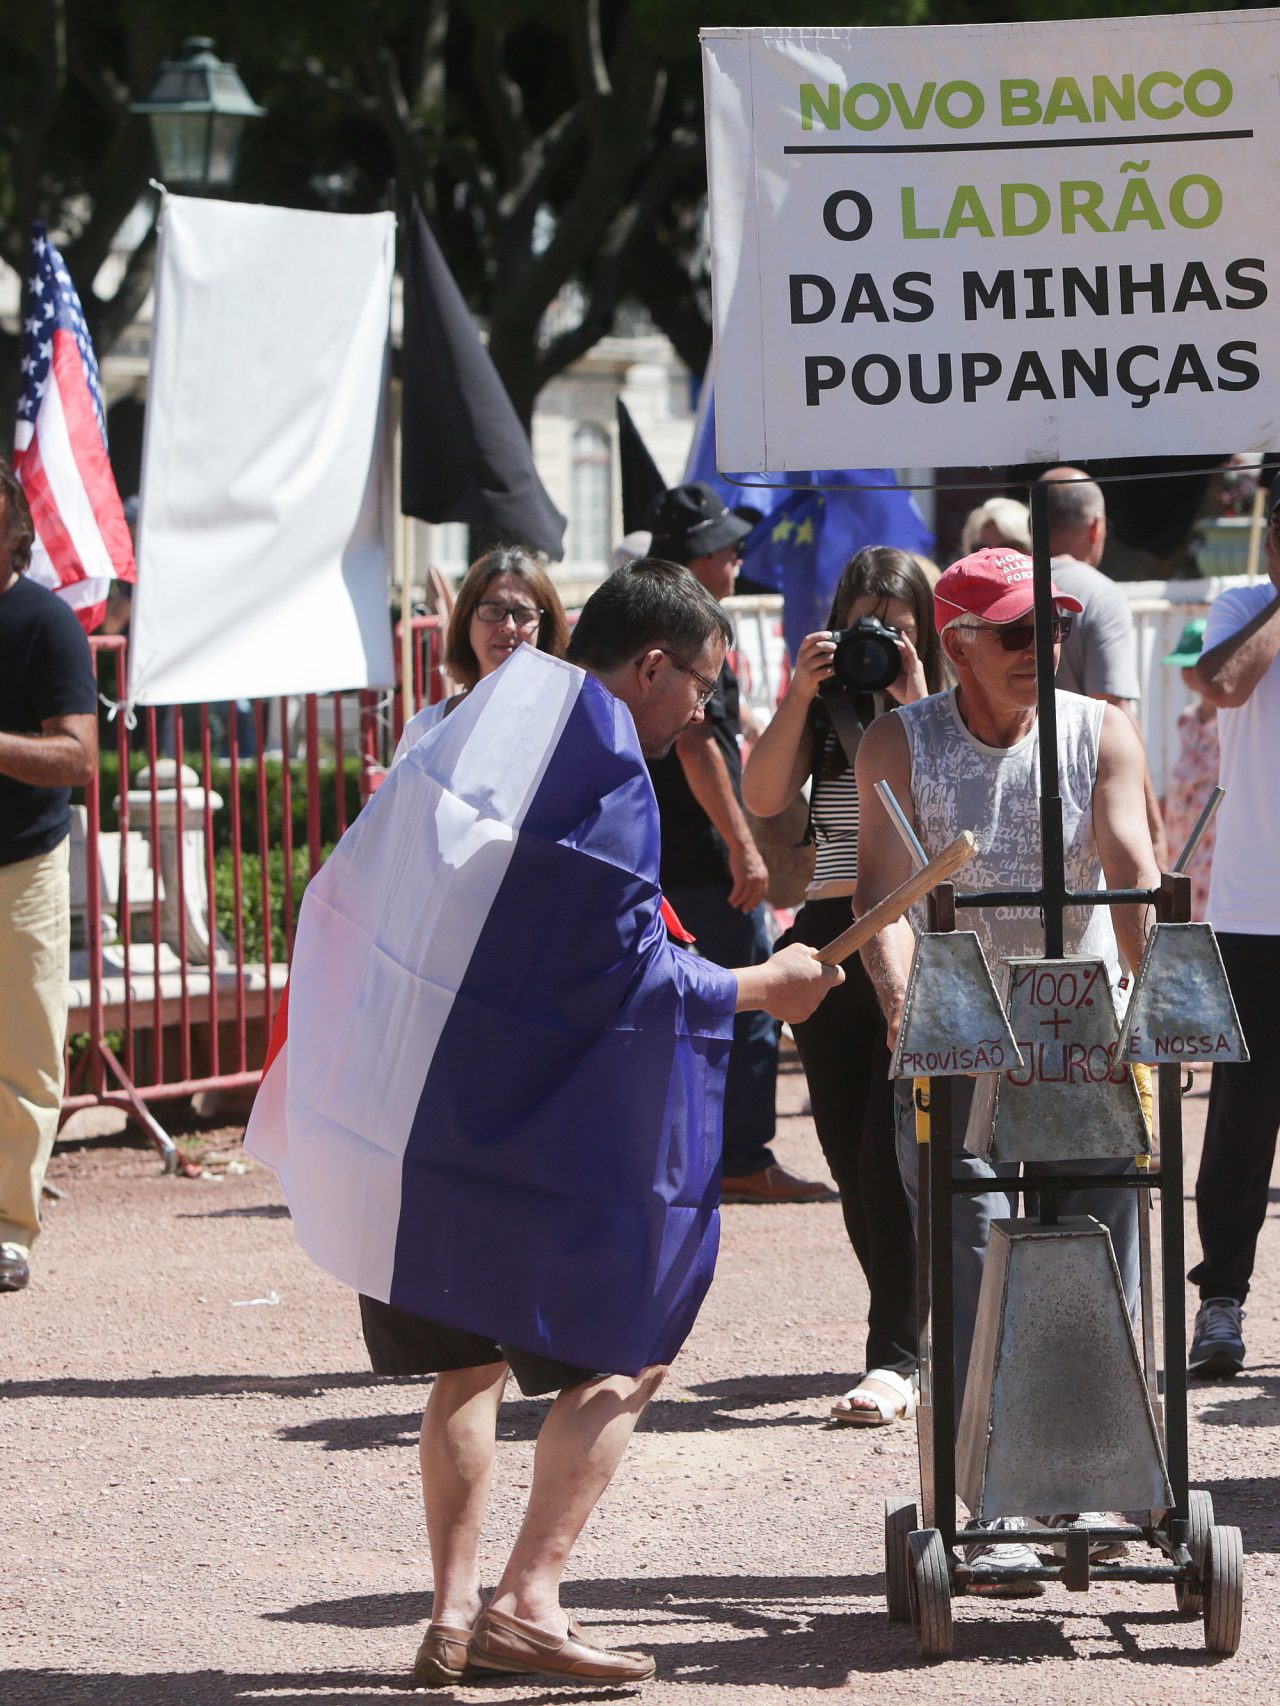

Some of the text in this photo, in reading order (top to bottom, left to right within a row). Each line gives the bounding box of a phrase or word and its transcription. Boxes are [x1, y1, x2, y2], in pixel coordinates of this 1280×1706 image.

[800, 68, 1233, 132] NOVO BANCO
[822, 159, 1223, 242] O LADRÃO
[788, 258, 1268, 325] DAS MINHAS
[804, 341, 1260, 410] POUPANÇAS
[1017, 965, 1103, 1009] 100%
[1154, 1032, 1231, 1056] NOSSA
